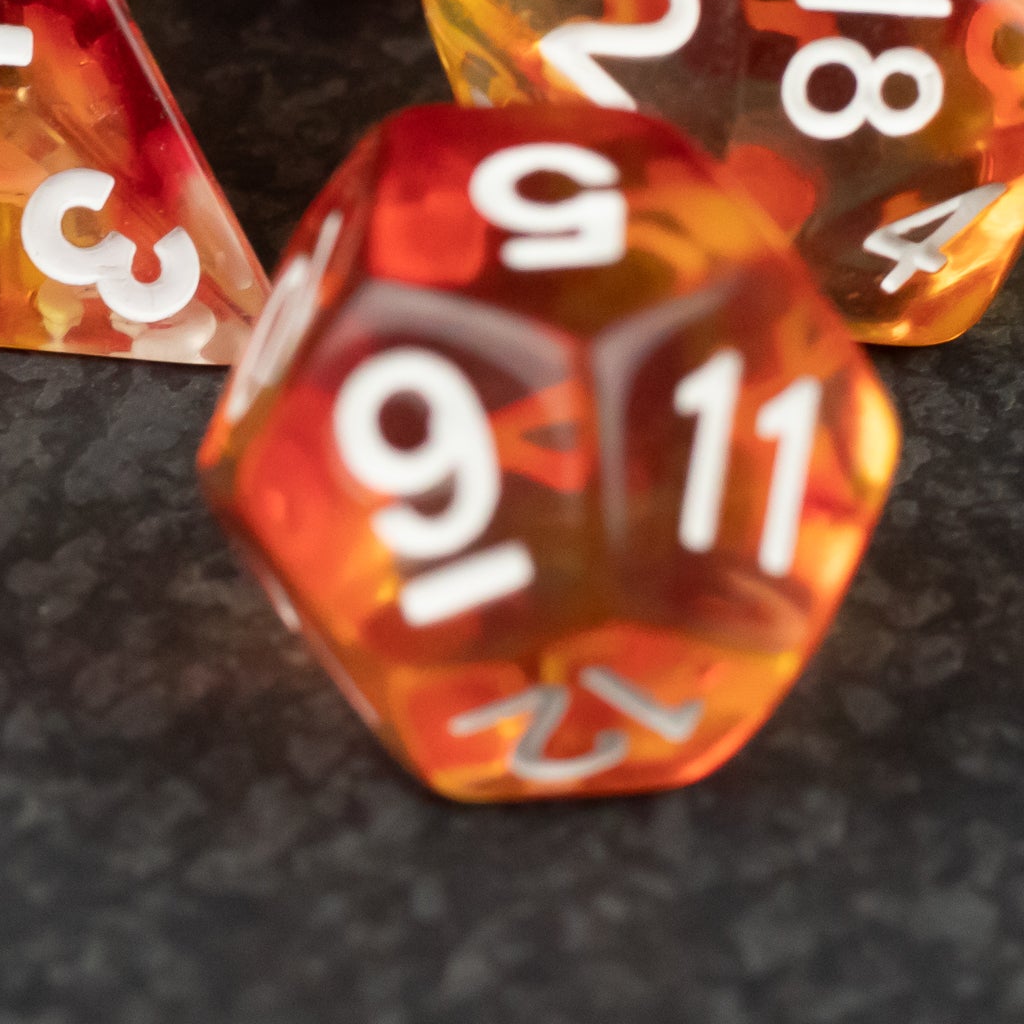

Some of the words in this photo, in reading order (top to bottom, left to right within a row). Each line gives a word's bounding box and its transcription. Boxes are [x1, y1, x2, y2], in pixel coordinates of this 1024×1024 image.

[21, 168, 200, 323] 3
[469, 142, 626, 270] 5
[863, 183, 1007, 294] 4
[675, 349, 822, 577] 11
[448, 666, 704, 783] 12
